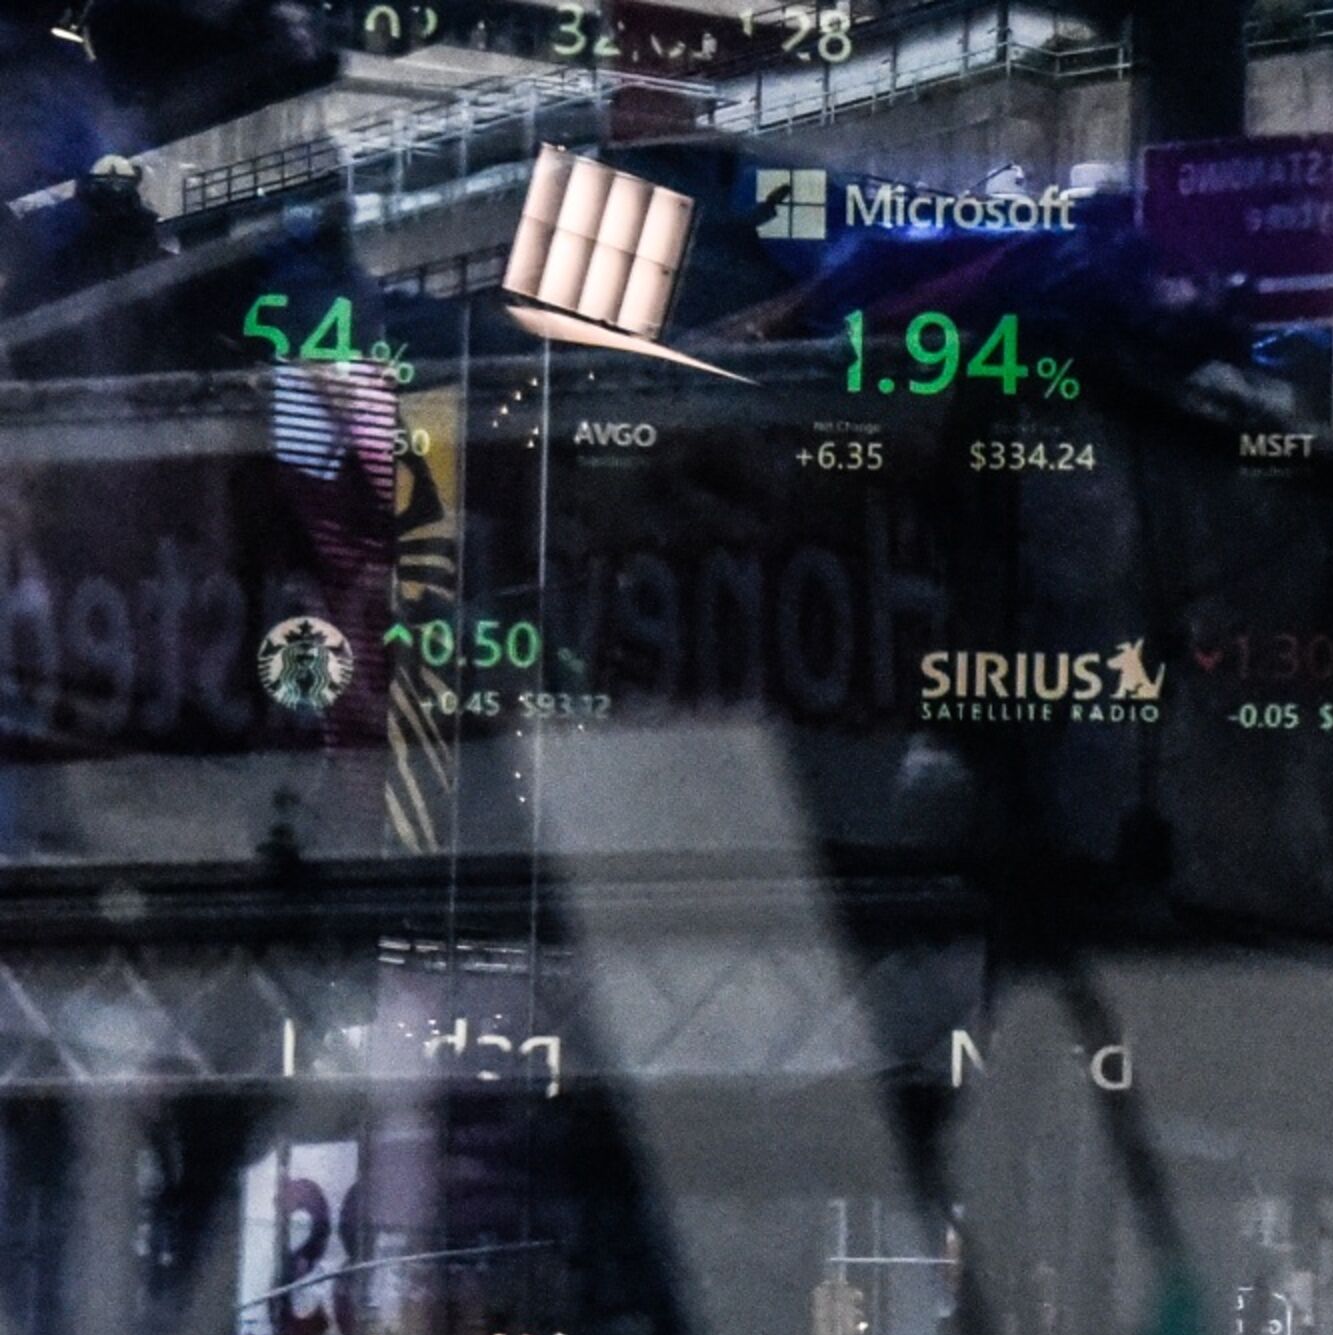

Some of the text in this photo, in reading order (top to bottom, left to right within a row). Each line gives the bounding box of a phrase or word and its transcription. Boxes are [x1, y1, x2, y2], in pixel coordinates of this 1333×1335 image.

[845, 185, 1075, 232] Microsoft
[843, 310, 1081, 400] 1.94%
[573, 420, 657, 448] AVGO
[1238, 432, 1317, 461] MSFT
[795, 441, 884, 472] +6.35
[968, 440, 1097, 474] $334.24
[920, 651, 1103, 700] SIRIUS
[920, 701, 1160, 724] SATELLITE RADIO
[1227, 703, 1301, 731] -0.05
